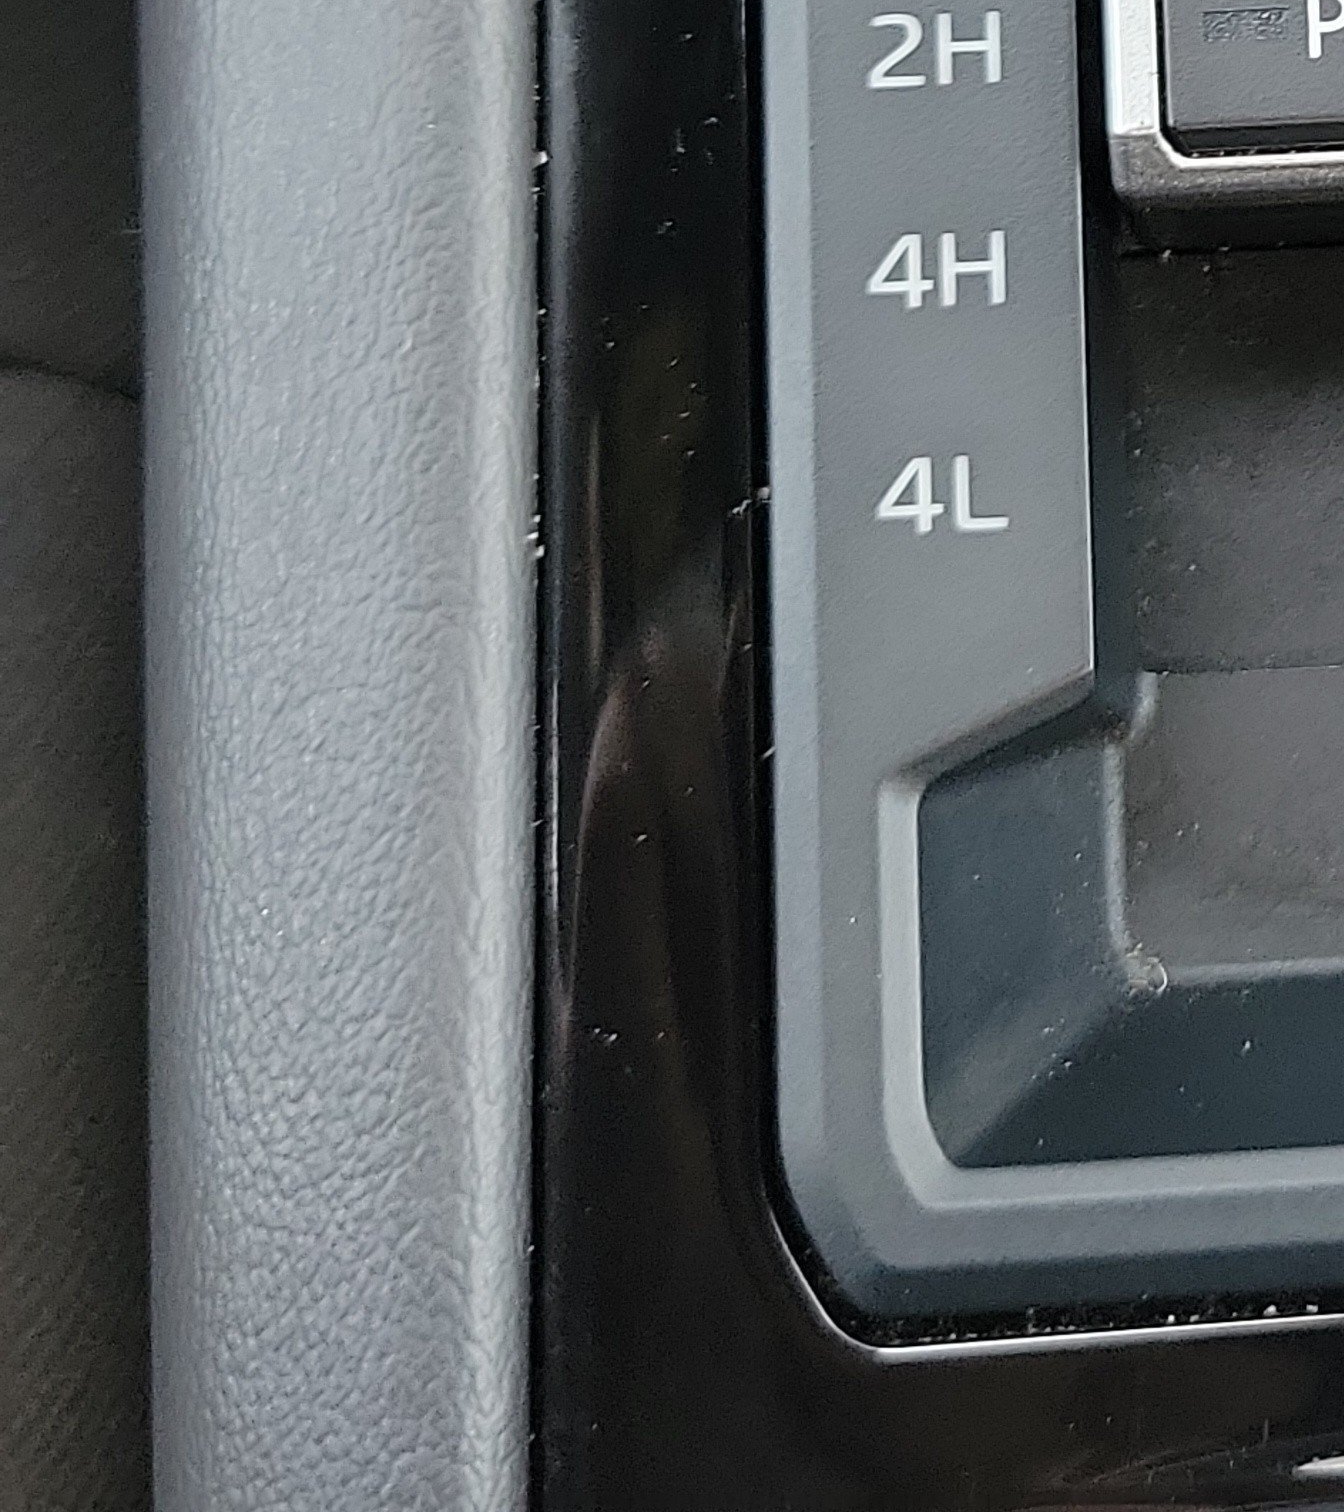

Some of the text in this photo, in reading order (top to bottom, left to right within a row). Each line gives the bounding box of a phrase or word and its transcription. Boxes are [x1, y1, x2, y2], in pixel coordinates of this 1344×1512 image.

[866, 9, 1003, 90] 2H
[866, 229, 1008, 310] 4H
[875, 452, 1010, 536] 4L
